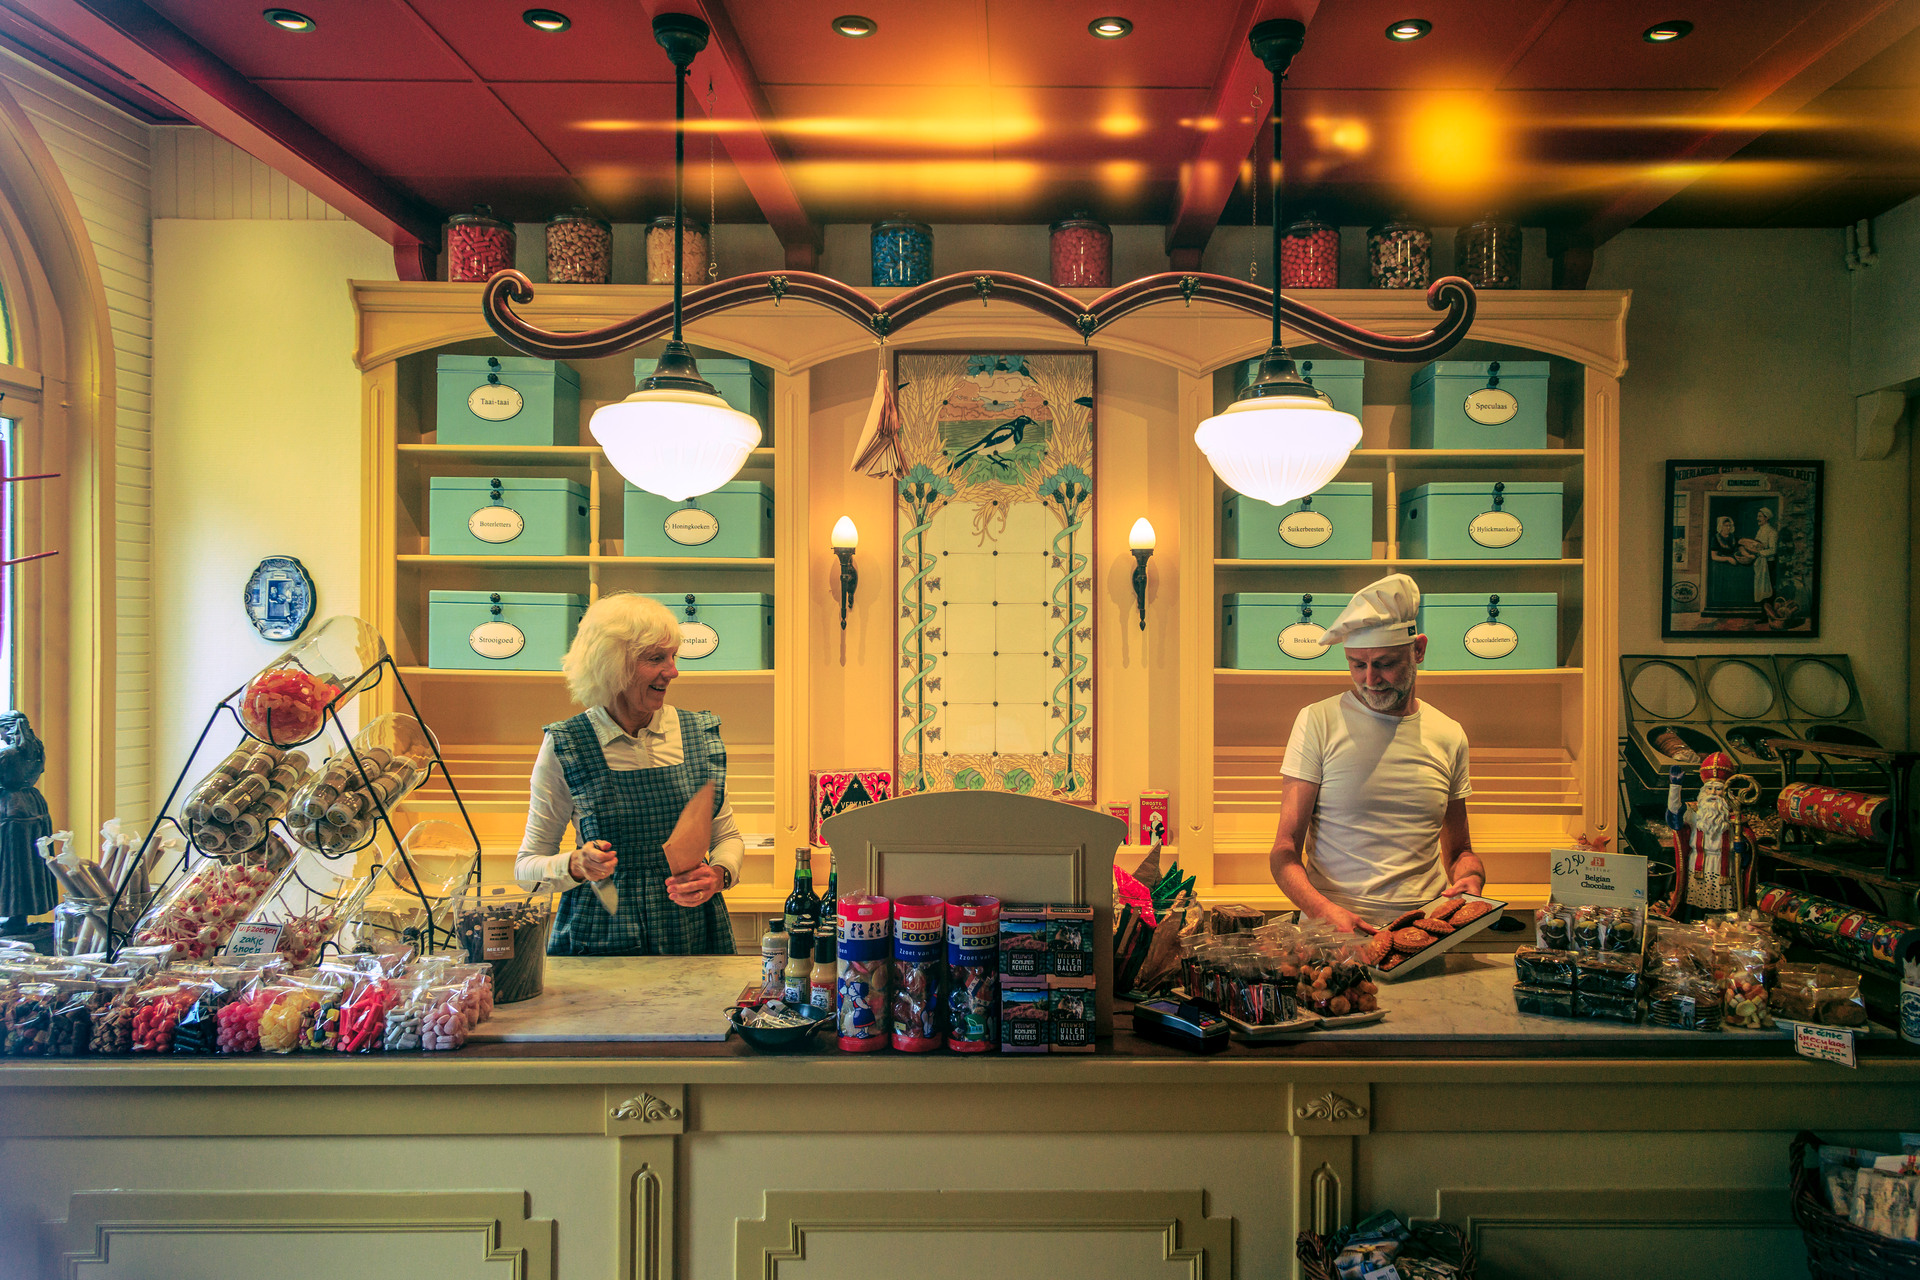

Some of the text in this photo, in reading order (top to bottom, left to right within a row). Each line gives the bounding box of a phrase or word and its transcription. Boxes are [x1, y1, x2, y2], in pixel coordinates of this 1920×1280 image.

[480, 398, 510, 406] Taai-taai
[1475, 402, 1507, 411] Speculaas
[479, 520, 511, 528] Boterletters
[672, 523, 710, 531] Honingkoeken
[1287, 525, 1325, 533] Suikerbeesten
[478, 635, 514, 645] Strooigoed
[680, 637, 707, 645] orstplaat
[1584, 874, 1611, 883] Belgian
[1580, 881, 1615, 891] Chocolate
[239, 935, 264, 948] zakje
[963, 936, 995, 946] FOOD
